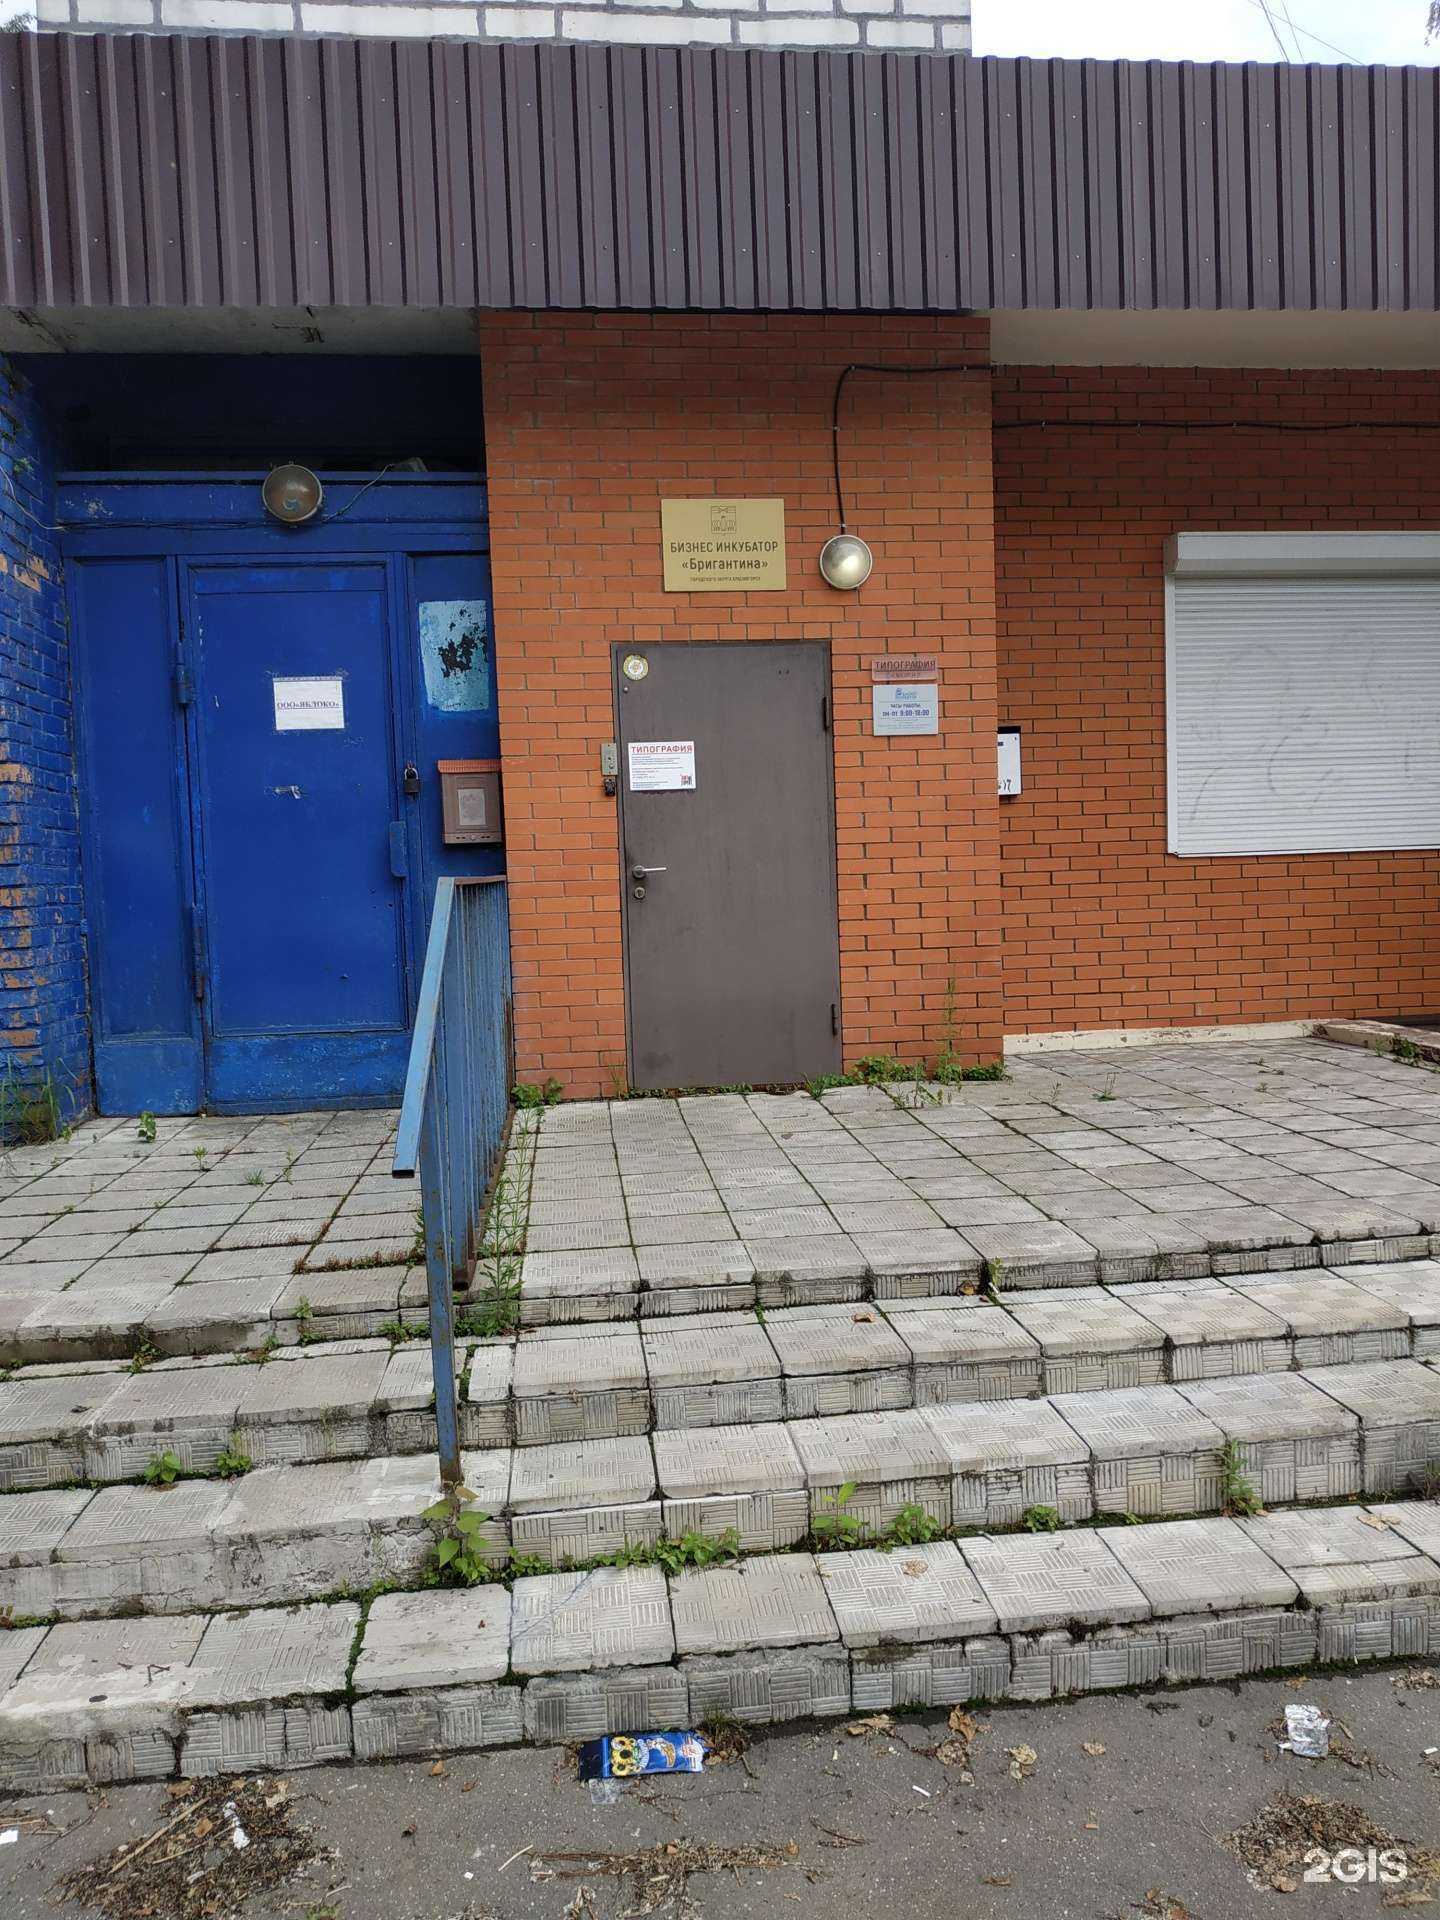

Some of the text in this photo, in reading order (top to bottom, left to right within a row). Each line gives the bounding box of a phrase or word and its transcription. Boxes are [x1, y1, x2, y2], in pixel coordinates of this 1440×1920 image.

[670, 541, 778, 553] БИЗНЕС ИНКУБАТОР
[682, 558, 768, 572] «Бригантина»
[875, 661, 936, 670] ТИПОГРАФИЯ
[631, 745, 693, 753] ТИПОГРАФИЯ
